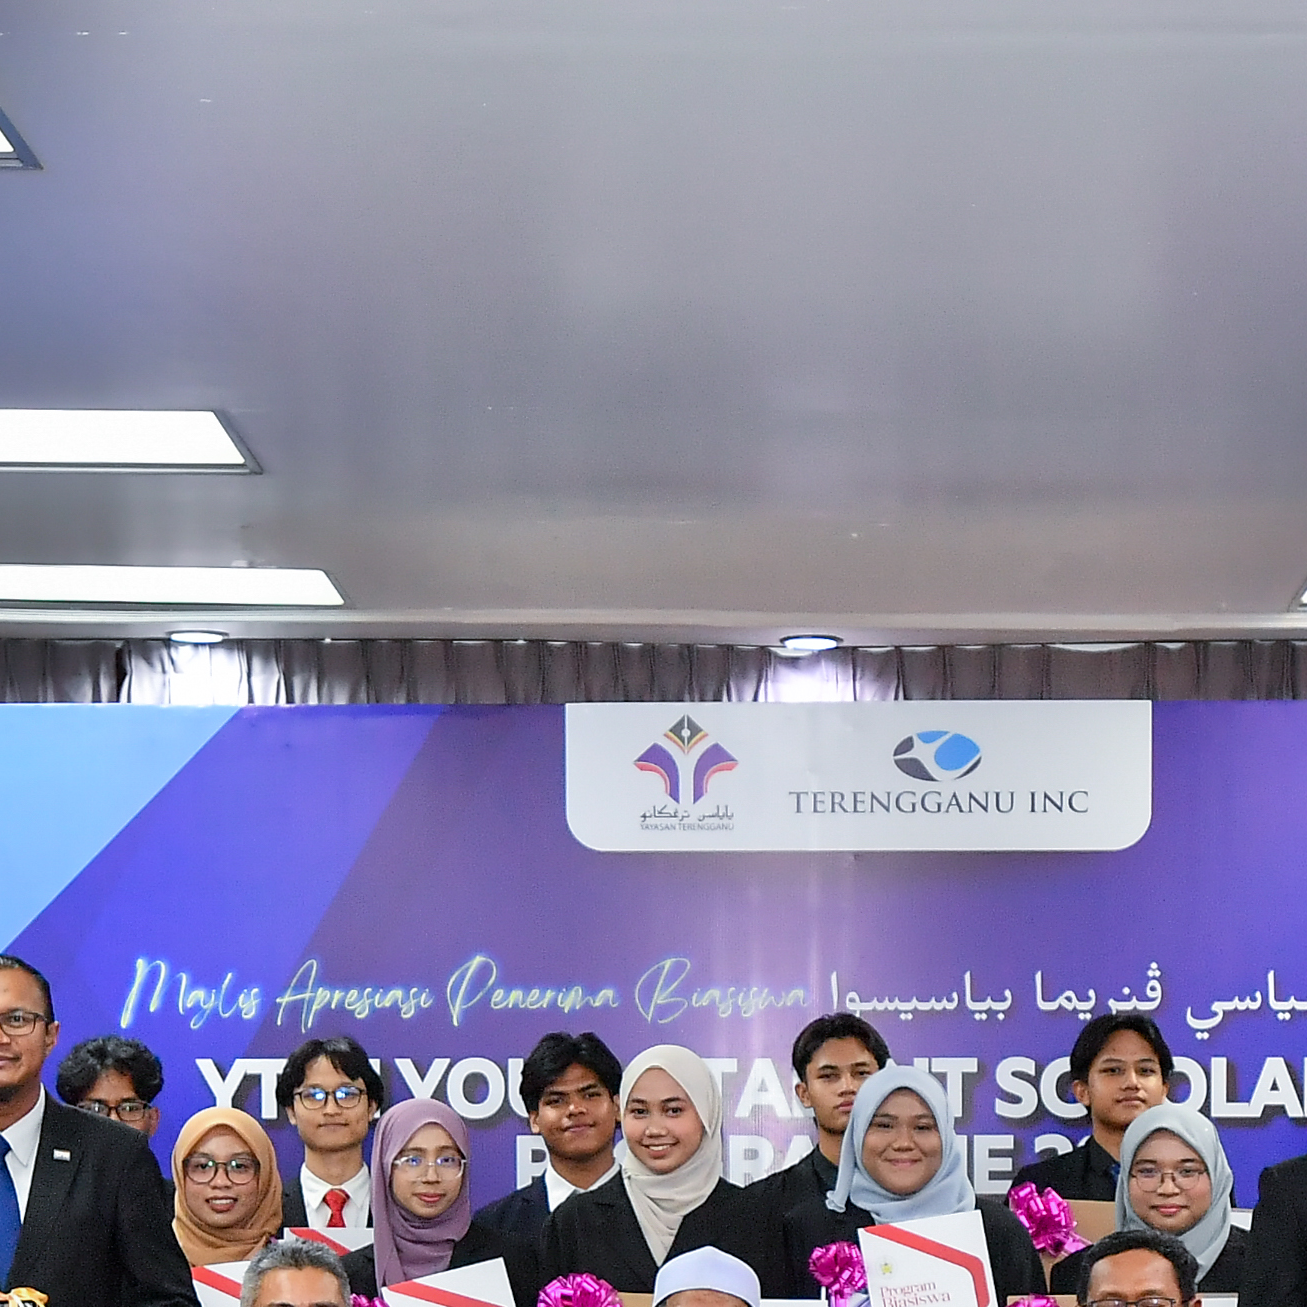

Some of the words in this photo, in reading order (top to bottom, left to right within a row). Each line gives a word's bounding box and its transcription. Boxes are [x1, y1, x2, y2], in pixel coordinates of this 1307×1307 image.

[789, 791, 1015, 814] TERENGGANU
[1029, 791, 1089, 814] INC
[640, 823, 676, 831] YAYASAN
[678, 823, 734, 831] TERENGGANU
[120, 958, 260, 1030] Majlis
[275, 958, 435, 1033] Apresiasi
[447, 955, 619, 1027] Penerima
[634, 957, 807, 1024] Biasiswa
[880, 1282, 936, 1297] Program
